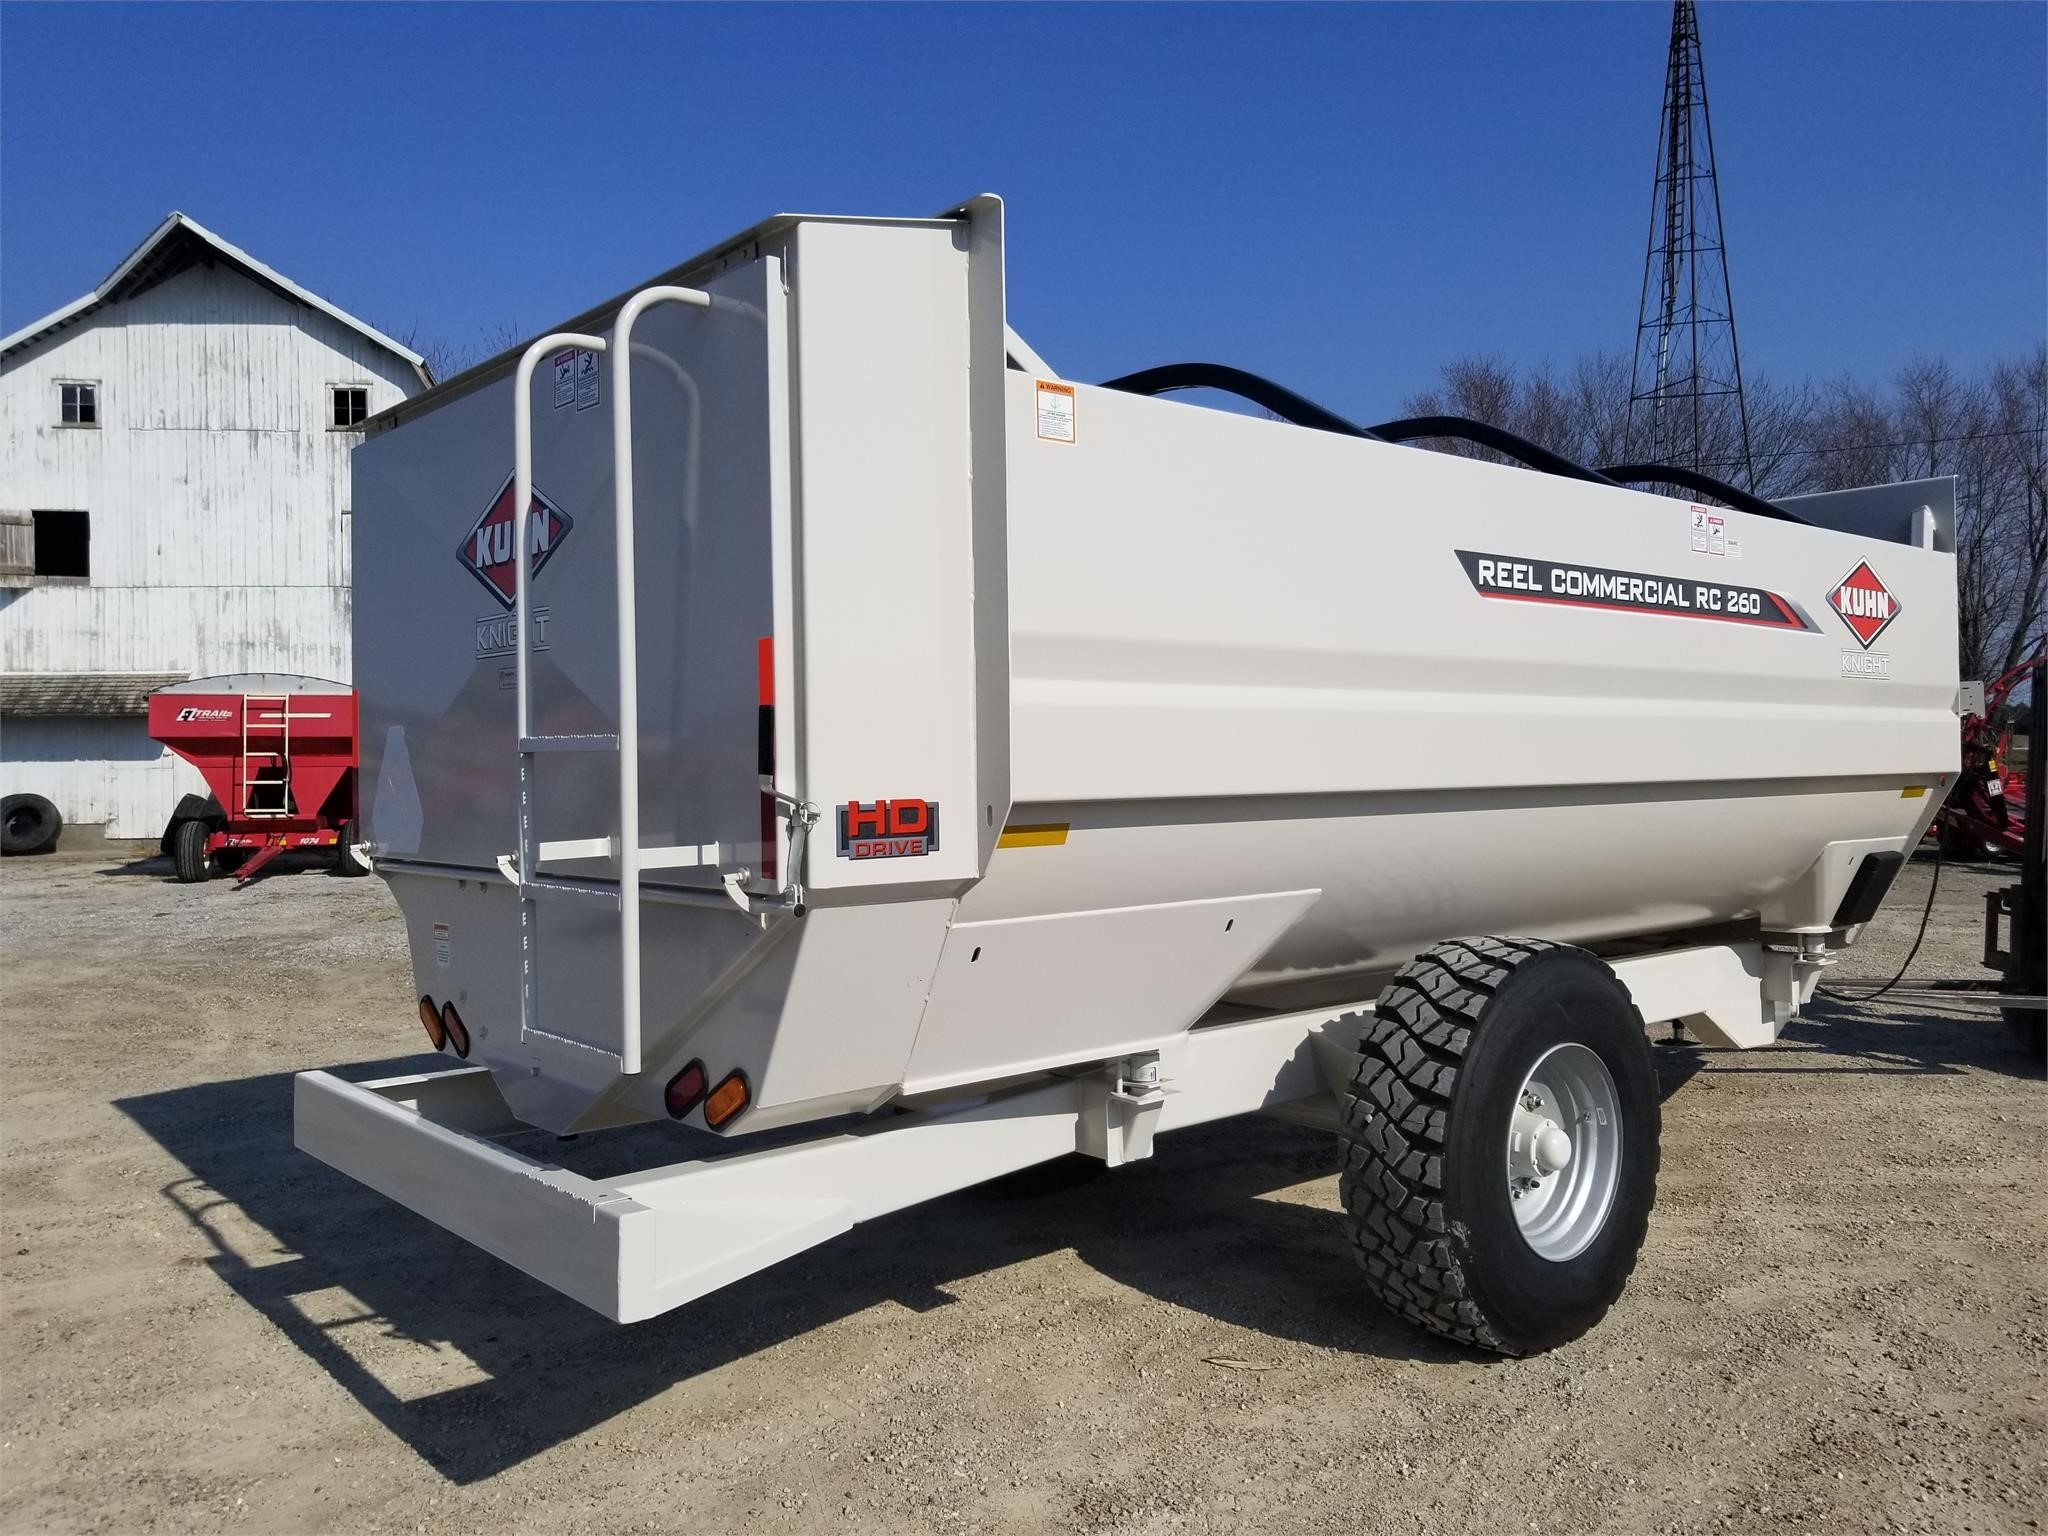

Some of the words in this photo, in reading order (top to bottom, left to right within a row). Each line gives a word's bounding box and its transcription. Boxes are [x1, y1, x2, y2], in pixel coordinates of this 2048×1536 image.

[1046, 384, 1072, 394] WARNING
[476, 509, 550, 568] KUN
[1478, 559, 1543, 591] REEL
[1551, 568, 1690, 607] COMMERCIAL
[1696, 586, 1721, 611] RC
[1727, 590, 1760, 615] 260
[1840, 585, 1889, 619] KUHN
[476, 615, 550, 651] KNIGT
[1841, 654, 1889, 675] KNIGHT
[848, 799, 928, 836] HD
[300, 837, 320, 845] 1074
[855, 840, 923, 857] DRIVE
